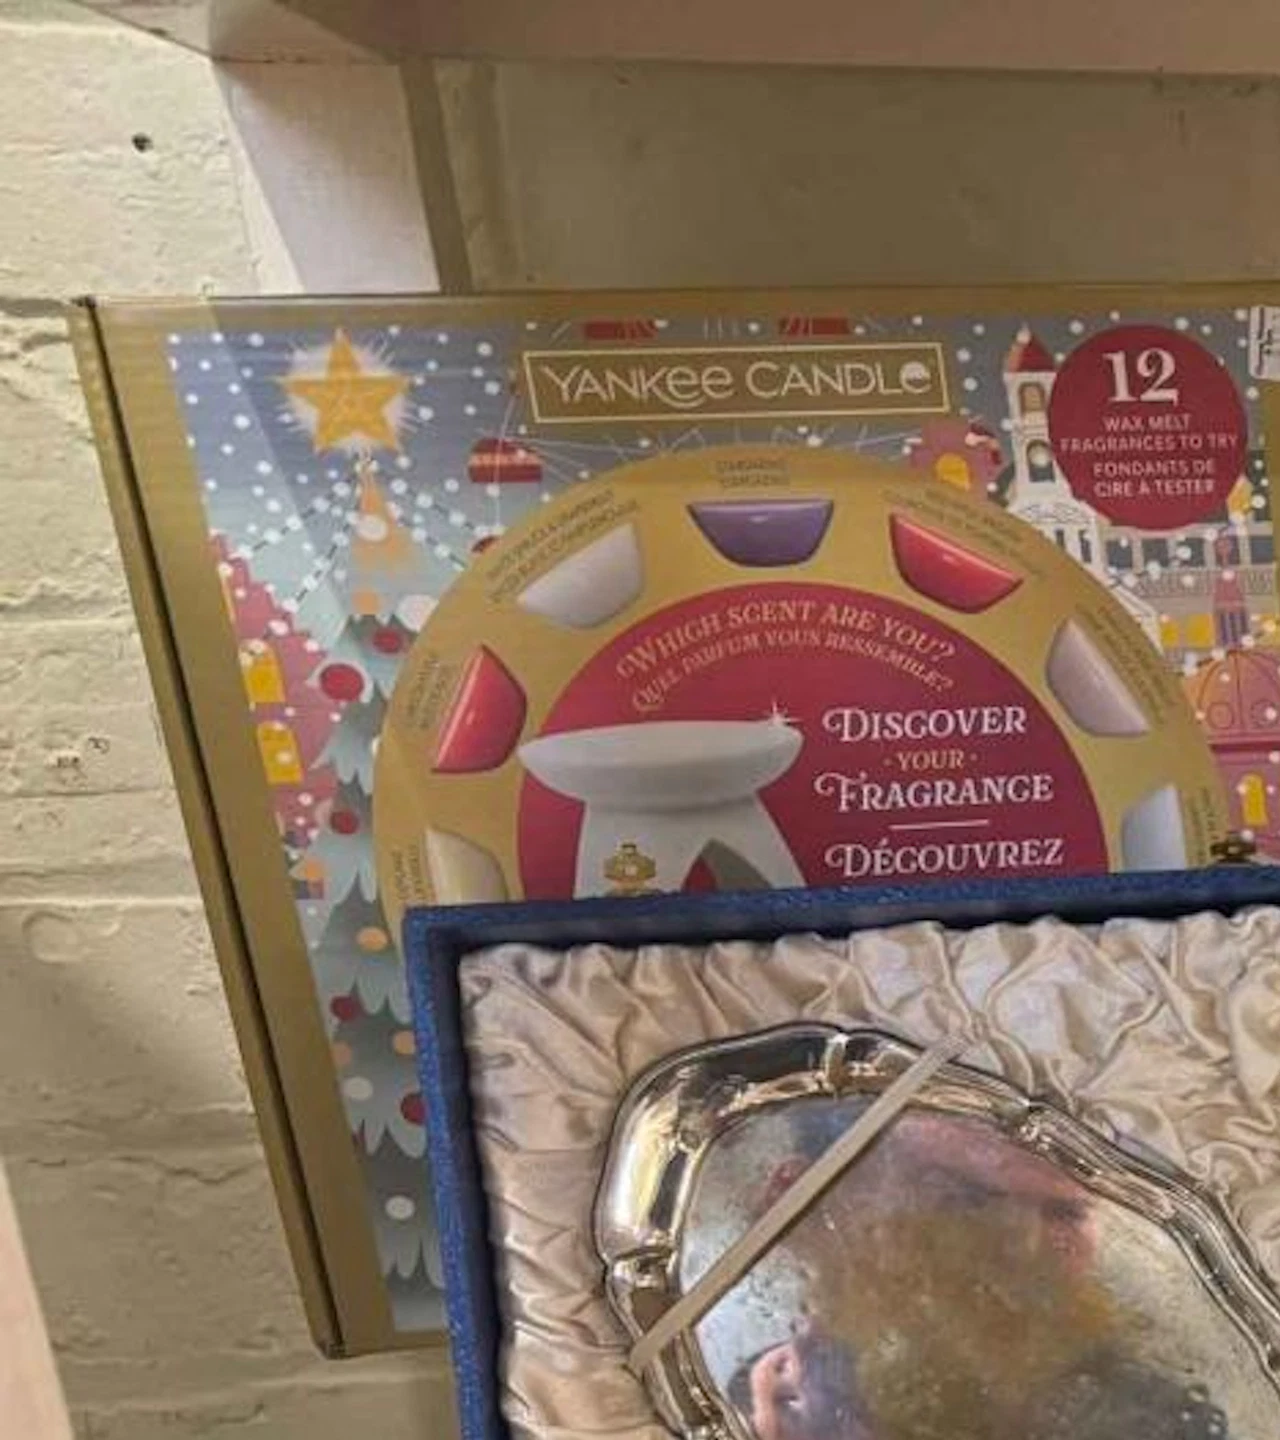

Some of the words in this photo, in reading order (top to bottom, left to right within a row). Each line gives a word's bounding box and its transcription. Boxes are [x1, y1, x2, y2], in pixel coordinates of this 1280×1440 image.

[1102, 347, 1180, 407] 12
[1102, 415, 1144, 432] WAX
[1149, 413, 1192, 431] MELT
[1060, 434, 1177, 453] FRAGRANCES
[1180, 434, 1203, 450] TO
[1207, 432, 1239, 449] TRY
[1093, 459, 1189, 477] FONDANTS
[1192, 457, 1217, 474] DE
[1093, 479, 1135, 498] CIRE
[1153, 478, 1216, 495] TESTER
[615, 612, 721, 679] WHICH
[727, 599, 817, 630] SCENT
[819, 603, 877, 632] ARE
[882, 614, 956, 662] YOU?
[822, 706, 1027, 742] DISCOVER
[898, 749, 964, 771] YOUR
[814, 771, 1055, 812] FRAGRANCE
[824, 838, 1065, 878] DÉCOUVREZ
